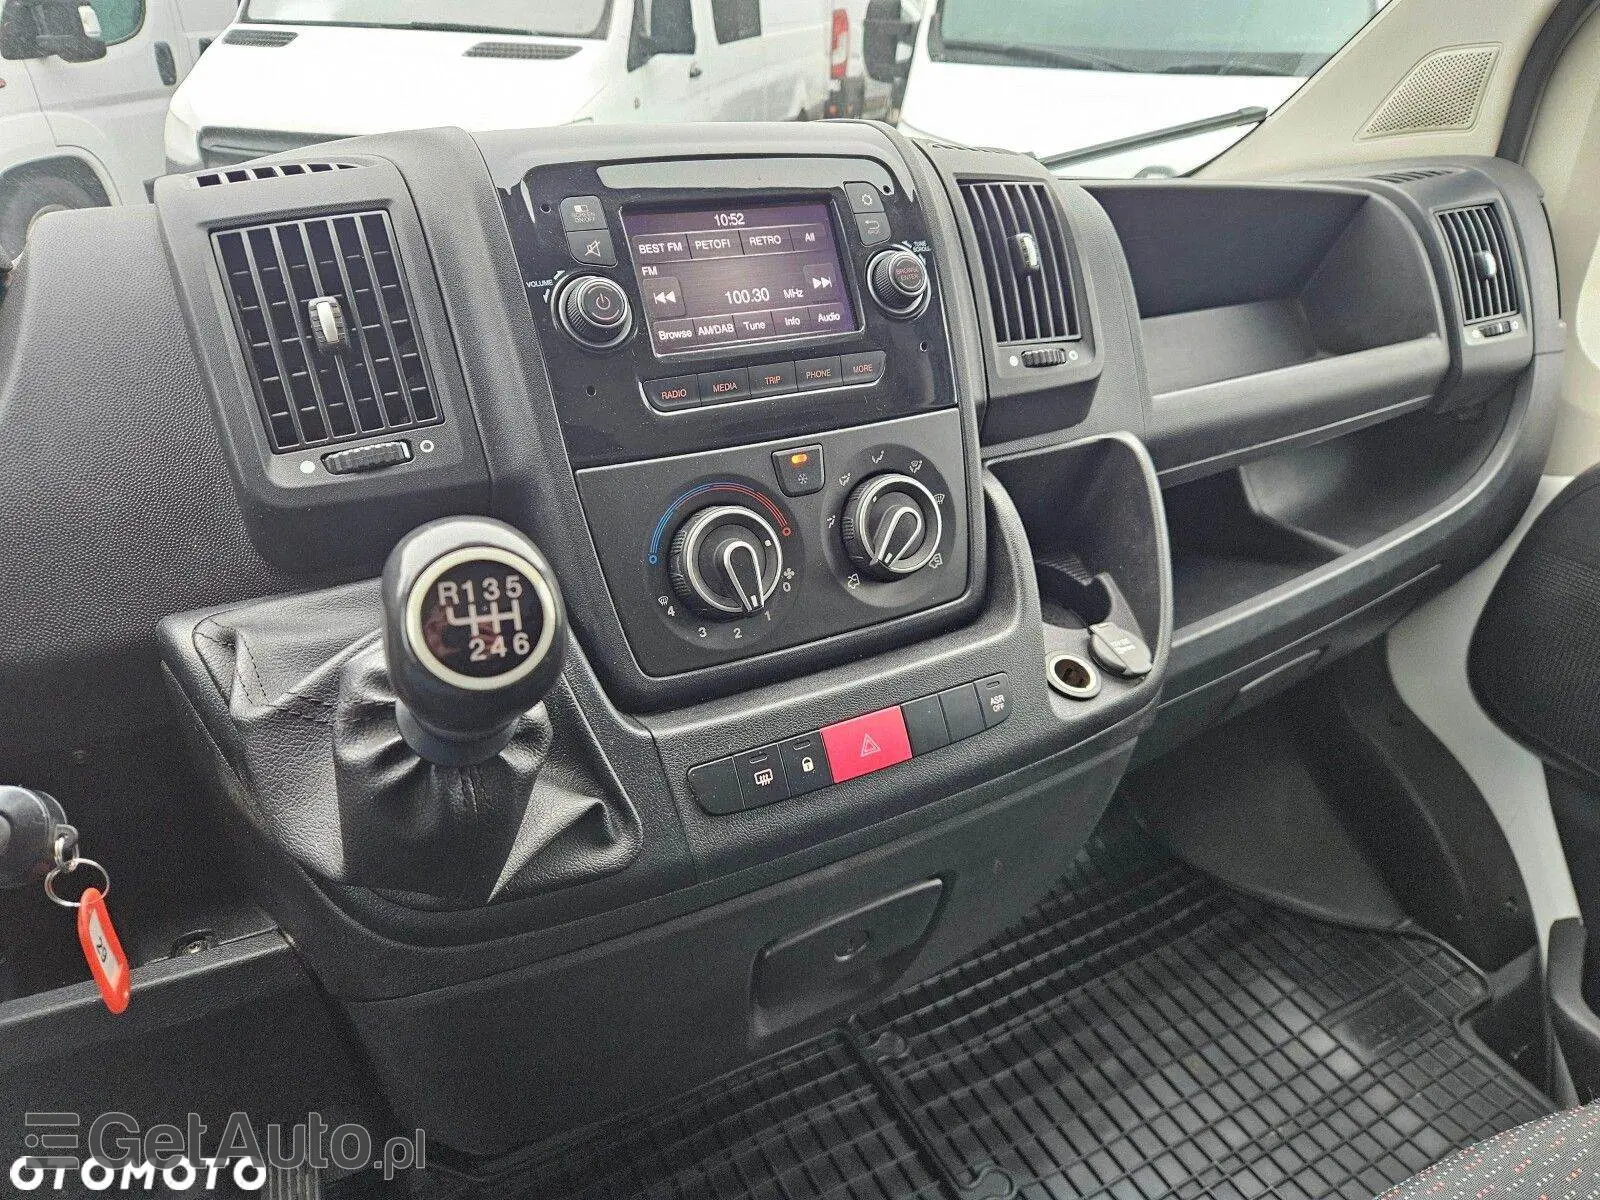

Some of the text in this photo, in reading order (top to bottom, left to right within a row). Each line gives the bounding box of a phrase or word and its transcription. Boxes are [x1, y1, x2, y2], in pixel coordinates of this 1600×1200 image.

[713, 212, 746, 227] 10:52
[749, 234, 782, 246] RETRO
[804, 232, 816, 242] All
[638, 241, 683, 255] BEST FM
[694, 238, 731, 250] PETOFI
[641, 265, 658, 276] FM
[525, 279, 554, 288] VOLUME
[724, 287, 804, 305] 100.30 MHz
[784, 316, 801, 326] Info
[817, 311, 841, 323] Audio
[697, 323, 735, 336] AM/DAB
[742, 321, 766, 332] Tune
[657, 329, 693, 341] Browse
[806, 368, 832, 380] PHONE
[852, 363, 873, 374] MORE
[764, 375, 781, 386] TRIP
[712, 382, 738, 393] MEDIA
[661, 388, 687, 400] RADIO
[667, 605, 676, 617] 4
[764, 611, 772, 621] 1
[698, 626, 707, 638] 3
[733, 627, 743, 639] 2
[990, 694, 1005, 706] ASR
[993, 702, 1005, 712] OFF
